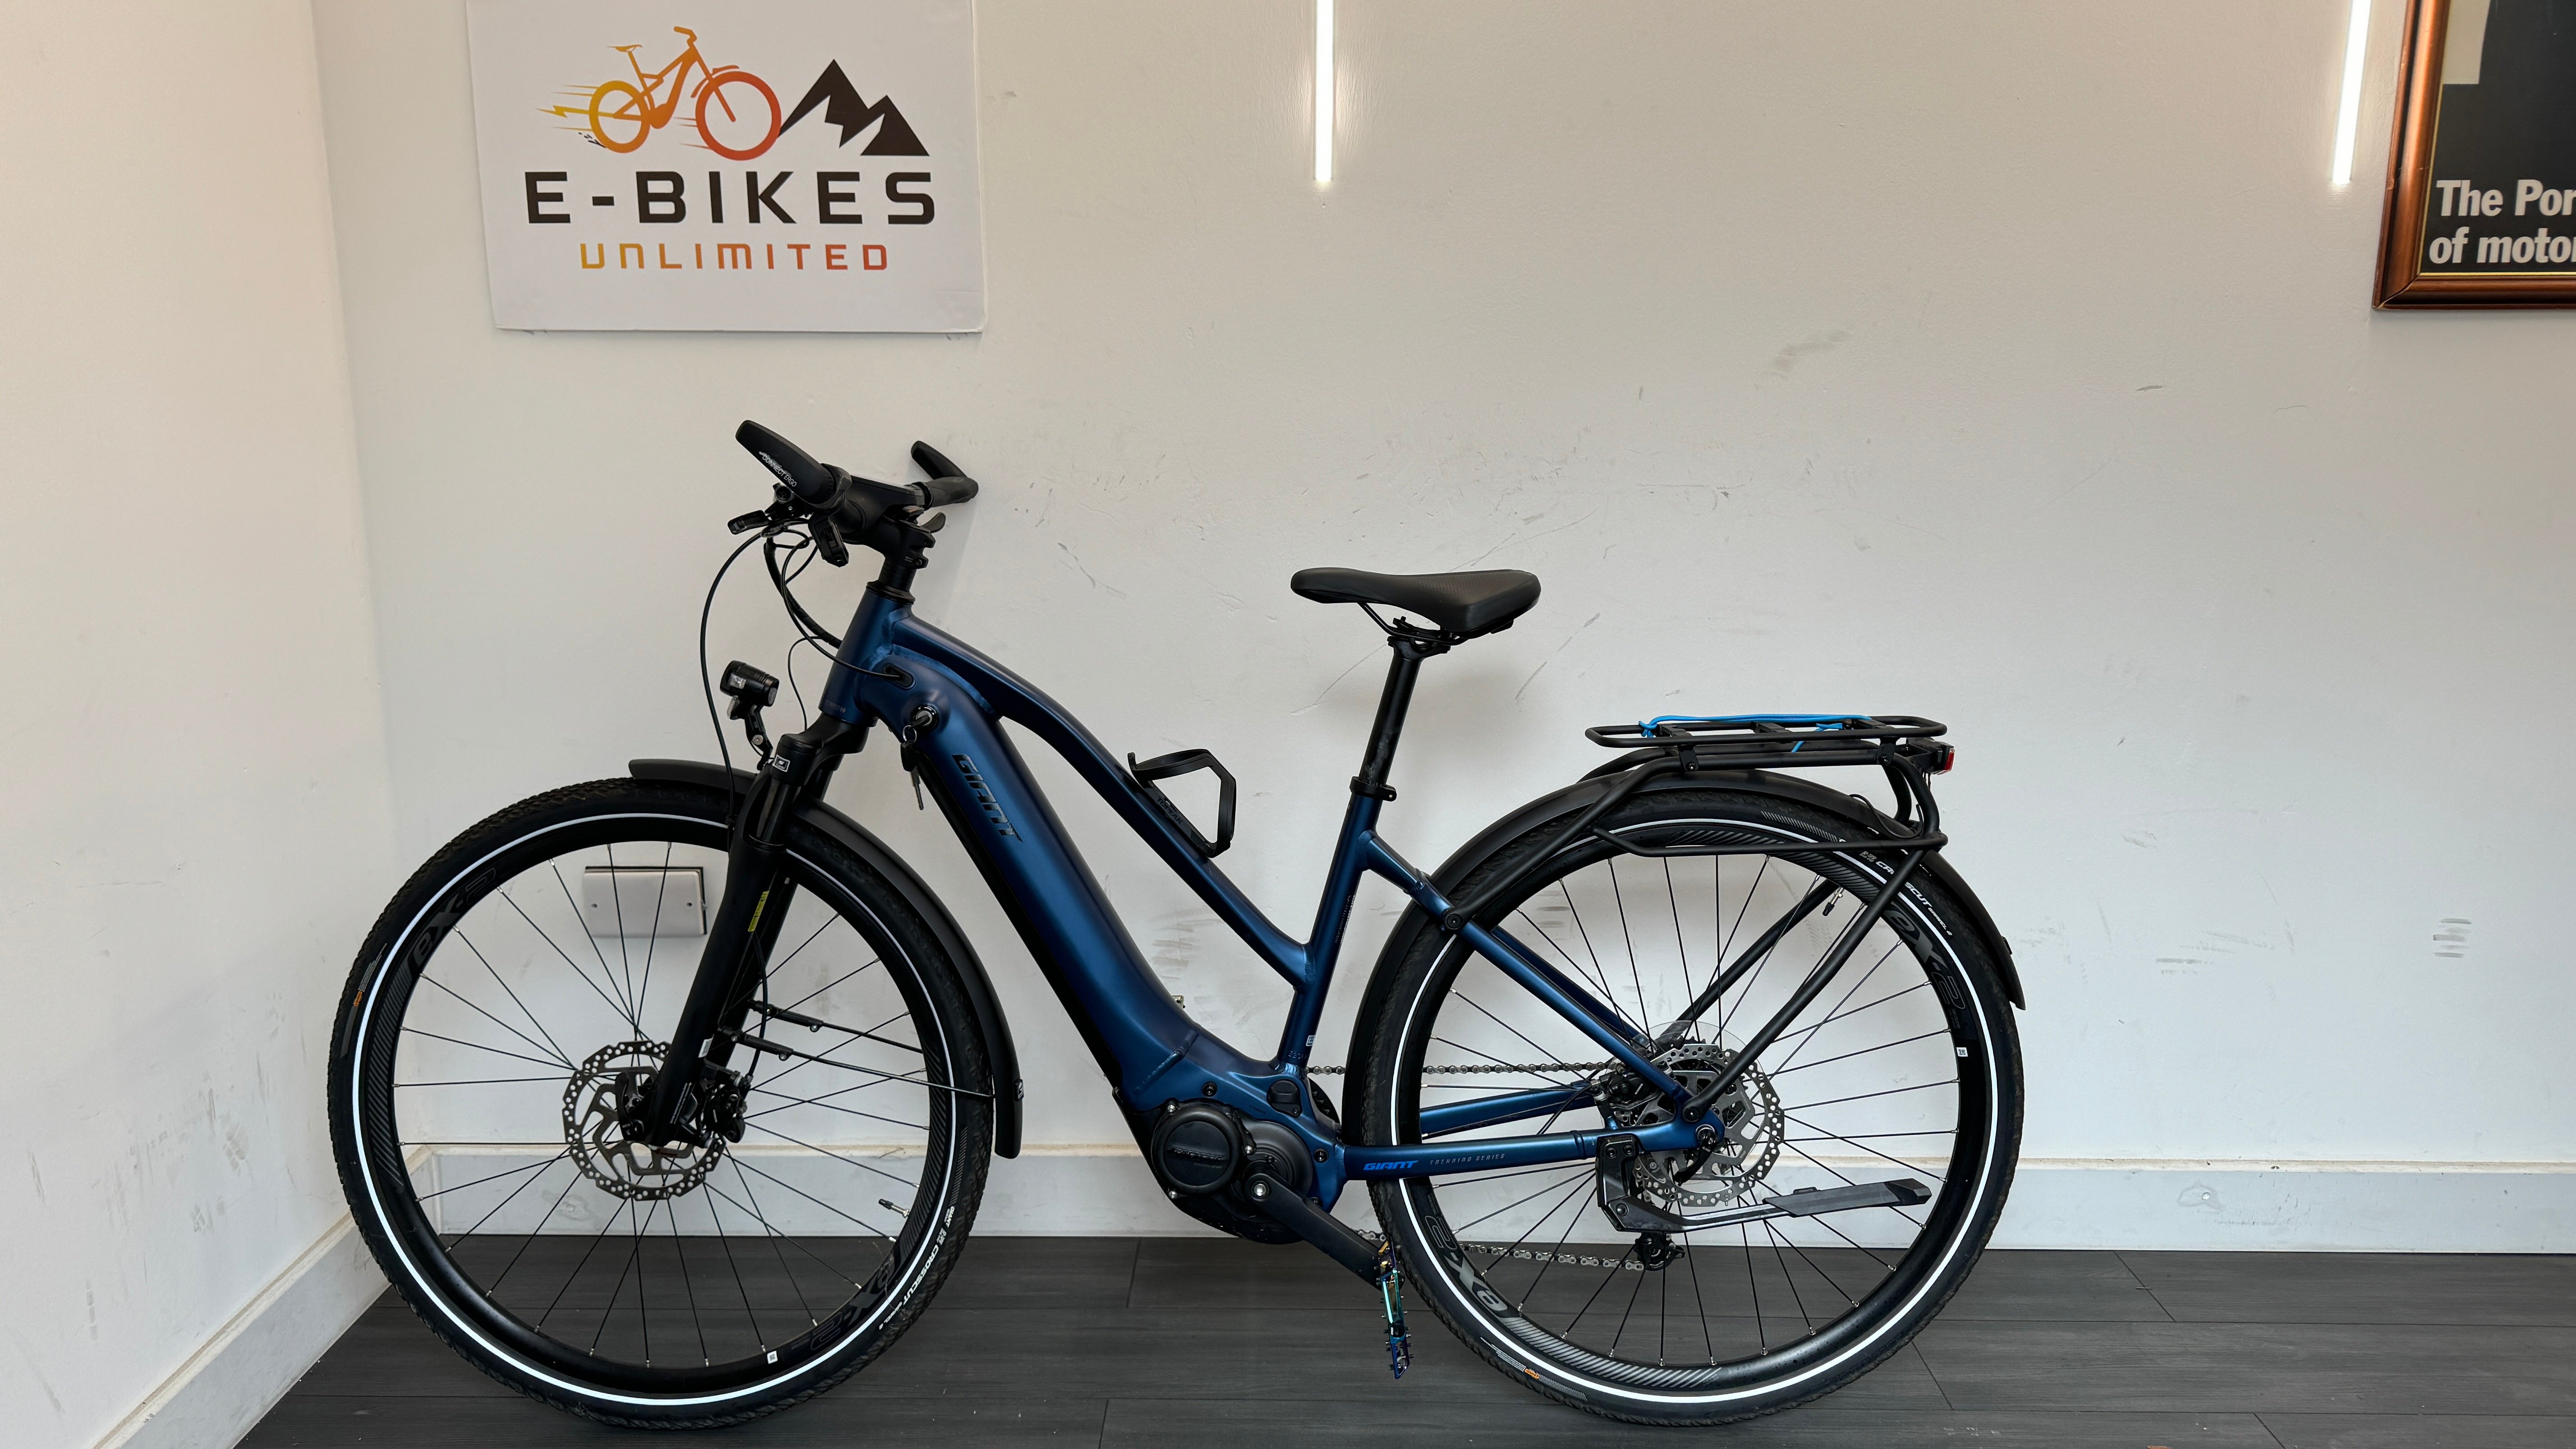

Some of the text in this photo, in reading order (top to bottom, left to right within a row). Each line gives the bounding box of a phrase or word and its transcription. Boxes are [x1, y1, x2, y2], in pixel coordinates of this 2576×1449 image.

[525, 171, 935, 225] E-BIKES
[2436, 179, 2503, 216] The
[580, 243, 888, 271] UNLIMITED
[2429, 226, 2470, 264] of
[762, 454, 797, 487] CONNECT ERGO
[952, 754, 1024, 842] GIANT
[1157, 796, 1183, 825] TOPEAK
[1363, 1160, 1419, 1171] GIANT
[903, 1244, 939, 1306] CROSSCUT
